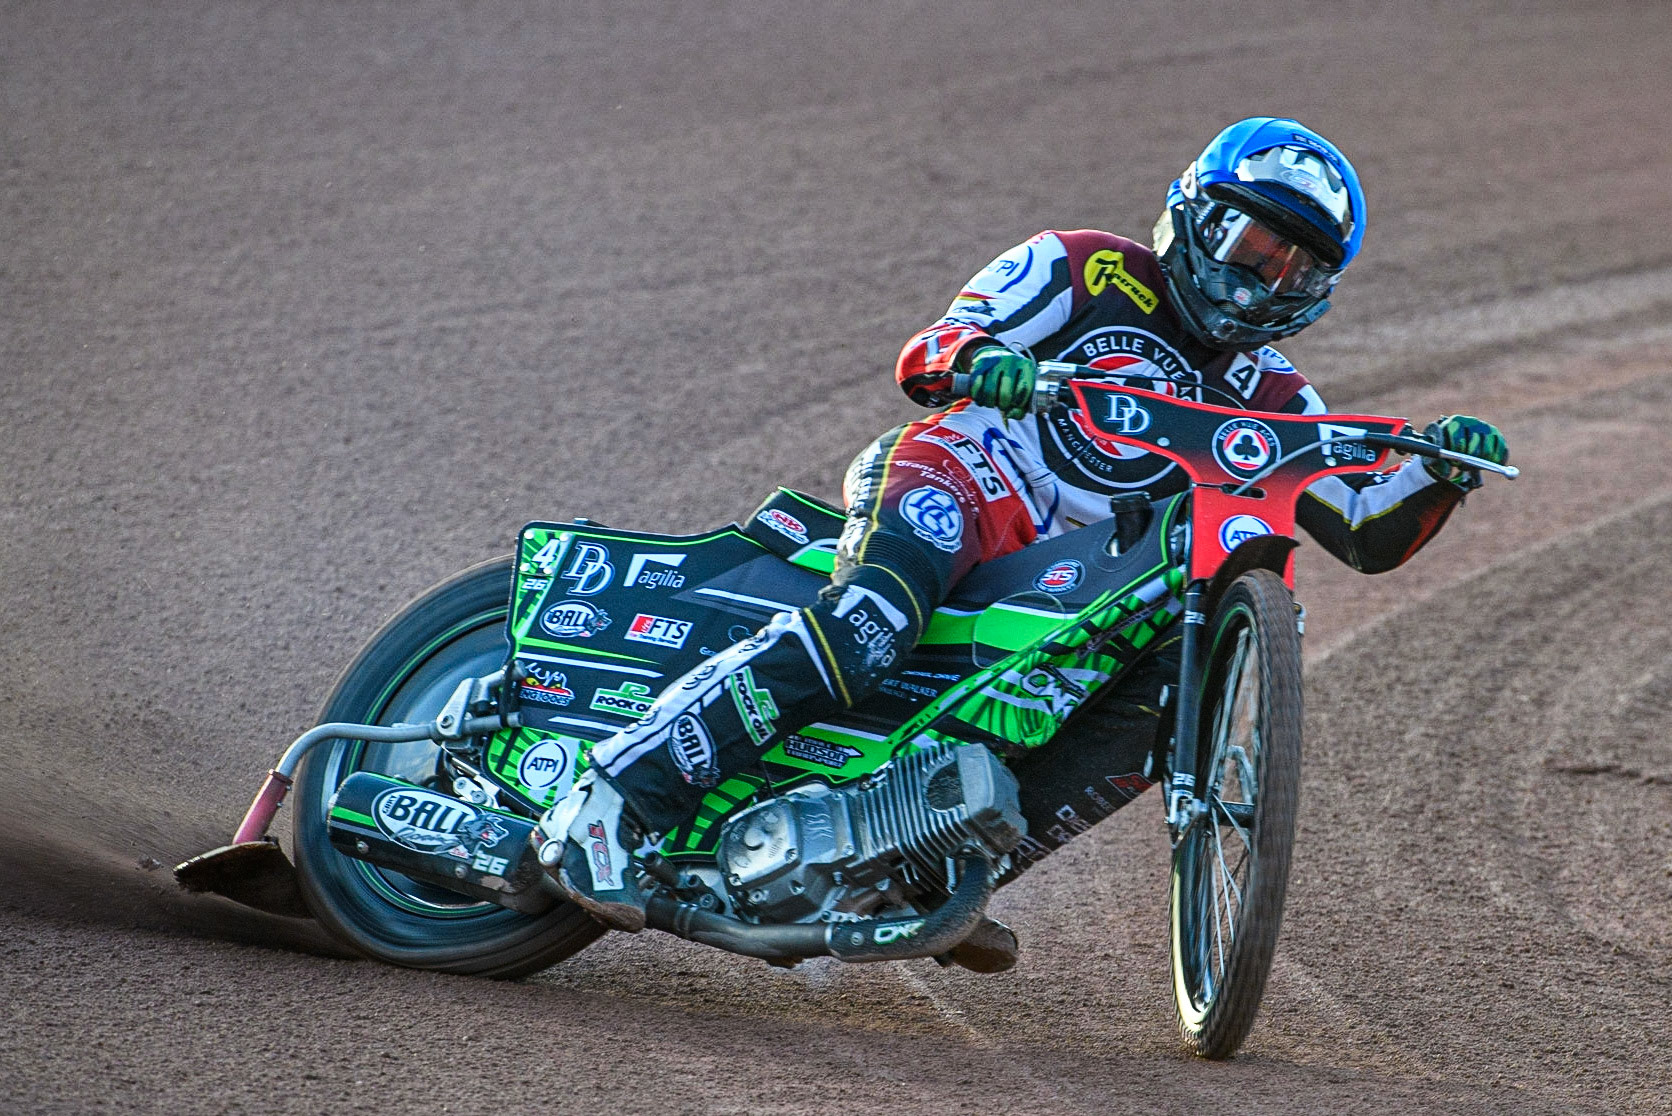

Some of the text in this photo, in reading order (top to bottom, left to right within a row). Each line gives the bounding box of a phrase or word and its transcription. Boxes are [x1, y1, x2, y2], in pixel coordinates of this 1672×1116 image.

[1082, 336, 1144, 357] BELLE
[1153, 348, 1186, 380] VUE
[1333, 441, 1376, 463] agilia
[894, 461, 936, 473] Grant
[953, 439, 1006, 496] FTS
[920, 470, 966, 504] Tankers
[532, 538, 561, 569] 4
[522, 578, 549, 591] 26
[638, 569, 686, 590] agilia
[648, 618, 689, 640] FTS
[595, 695, 636, 710] ROCK
[735, 672, 758, 716] ROCK
[752, 718, 769, 740] OIL
[527, 757, 560, 773] ATPI
[387, 794, 471, 835] BALL
[472, 851, 510, 876] 26
